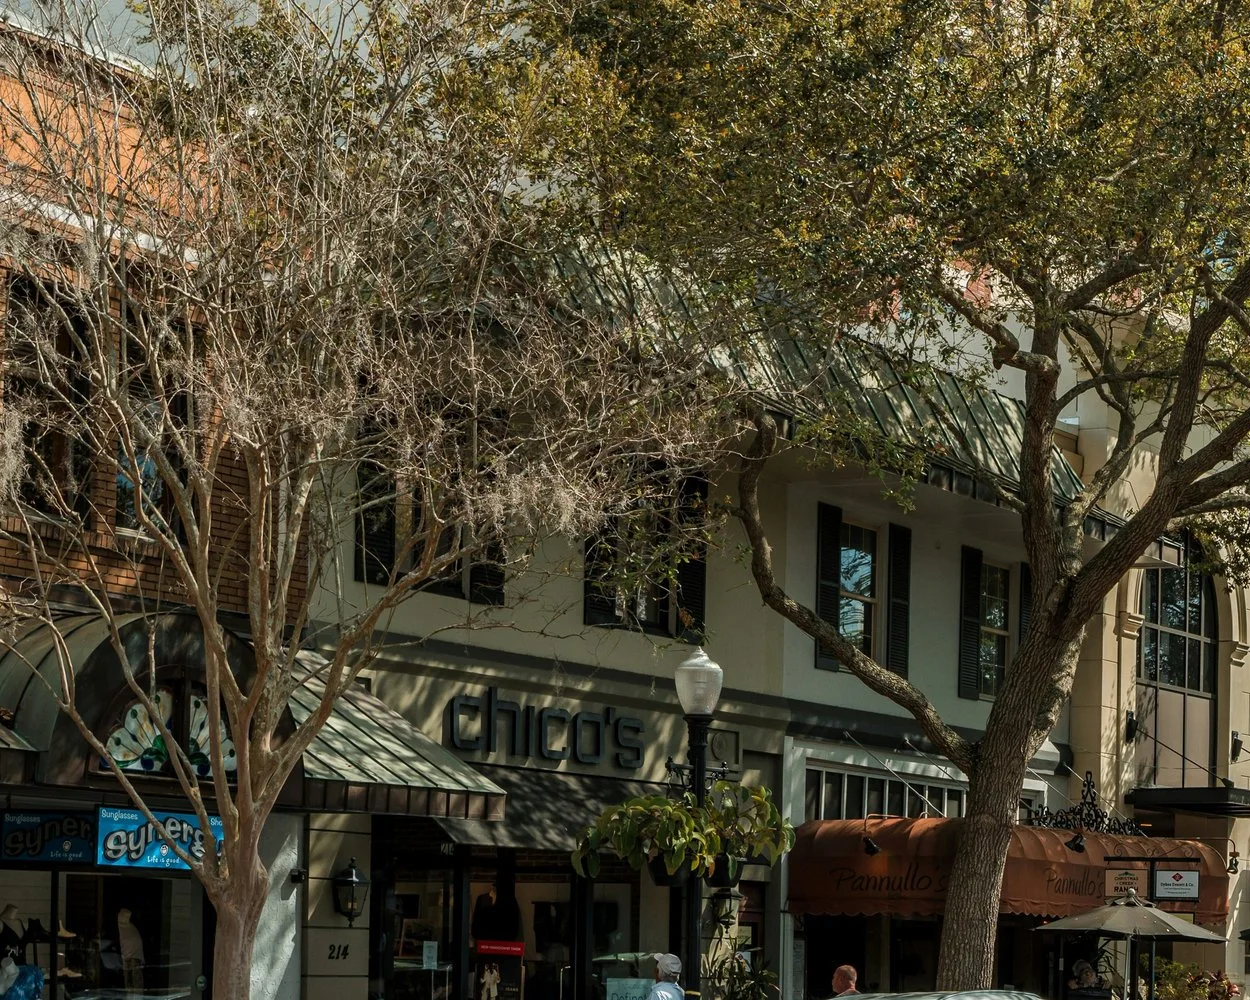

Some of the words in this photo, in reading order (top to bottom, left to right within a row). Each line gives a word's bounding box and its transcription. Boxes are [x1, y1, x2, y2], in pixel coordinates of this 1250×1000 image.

[451, 686, 645, 769] chico's
[102, 810, 138, 821] Sunglasses
[5, 817, 93, 857] syner
[105, 815, 225, 861] synerg
[147, 855, 159, 863] Life
[166, 857, 180, 866] good
[1044, 867, 1104, 899] Pannullo's
[328, 944, 349, 960] 214
